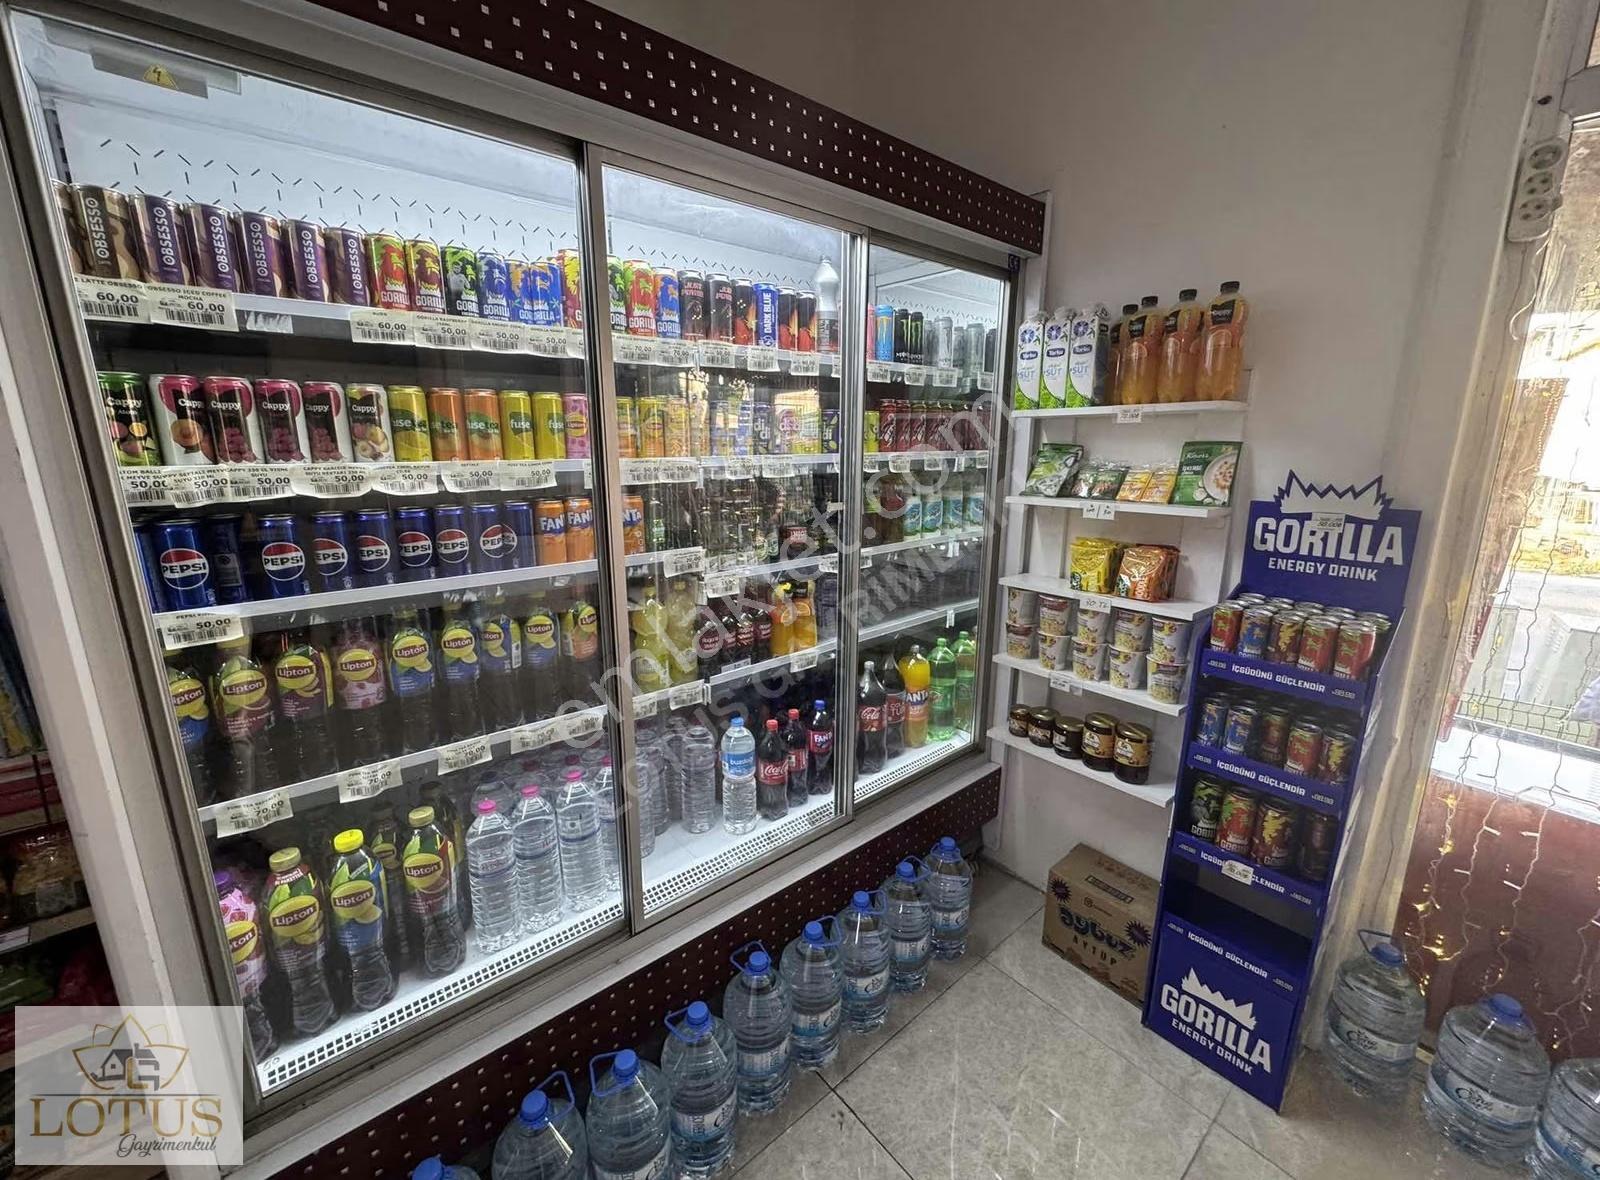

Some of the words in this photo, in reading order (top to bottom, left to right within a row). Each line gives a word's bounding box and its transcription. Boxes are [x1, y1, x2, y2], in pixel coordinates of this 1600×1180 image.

[85, 197, 109, 259] OBSESSO
[153, 206, 175, 265] OBSESSO
[209, 215, 230, 273] OBSESSO
[250, 221, 268, 276] OBSESSO
[301, 230, 319, 284] OBSESSO
[346, 238, 363, 290] OBSESSO
[96, 291, 139, 305] 60,00
[187, 301, 225, 313] 60,00
[378, 322, 407, 331] 60,00
[441, 327, 467, 336] 50,00
[496, 332, 520, 340] 50,00
[106, 396, 142, 409] Cappy
[177, 397, 202, 409] Capp
[211, 398, 240, 412] Cappy
[261, 401, 290, 413] Cappy
[304, 402, 329, 413] Cappy
[351, 403, 377, 414] Cappy
[510, 419, 530, 428] fuse
[334, 475, 365, 483] 50,00
[402, 473, 428, 481] 50,00
[469, 470, 493, 478] 50,00
[194, 478, 228, 489] 50,00
[257, 477, 290, 486] 50,00
[541, 517, 564, 531] FAN
[1253, 516, 1405, 566] GORILLA
[317, 551, 347, 562] EPSI
[360, 548, 389, 558] EPSI
[263, 554, 304, 567] PEPSI
[161, 561, 207, 575] PEPSI
[1268, 557, 1327, 575] ENERGY
[1328, 563, 1379, 582] DRINK
[196, 617, 231, 630] 50,00
[527, 623, 552, 634] Lipton
[445, 637, 472, 648] Lipton
[396, 645, 426, 656] Lipton
[278, 666, 311, 678] Lipton
[341, 660, 373, 671] Lipton
[225, 681, 264, 695] Lipton
[174, 689, 203, 705] ipton
[406, 863, 440, 878] Lipton
[334, 890, 372, 907] Lipton
[275, 905, 316, 927] Lipton
[1160, 983, 1272, 1075] GORILLA
[1172, 1018, 1215, 1050] ENERGY
[1217, 1044, 1254, 1076] DRINK
